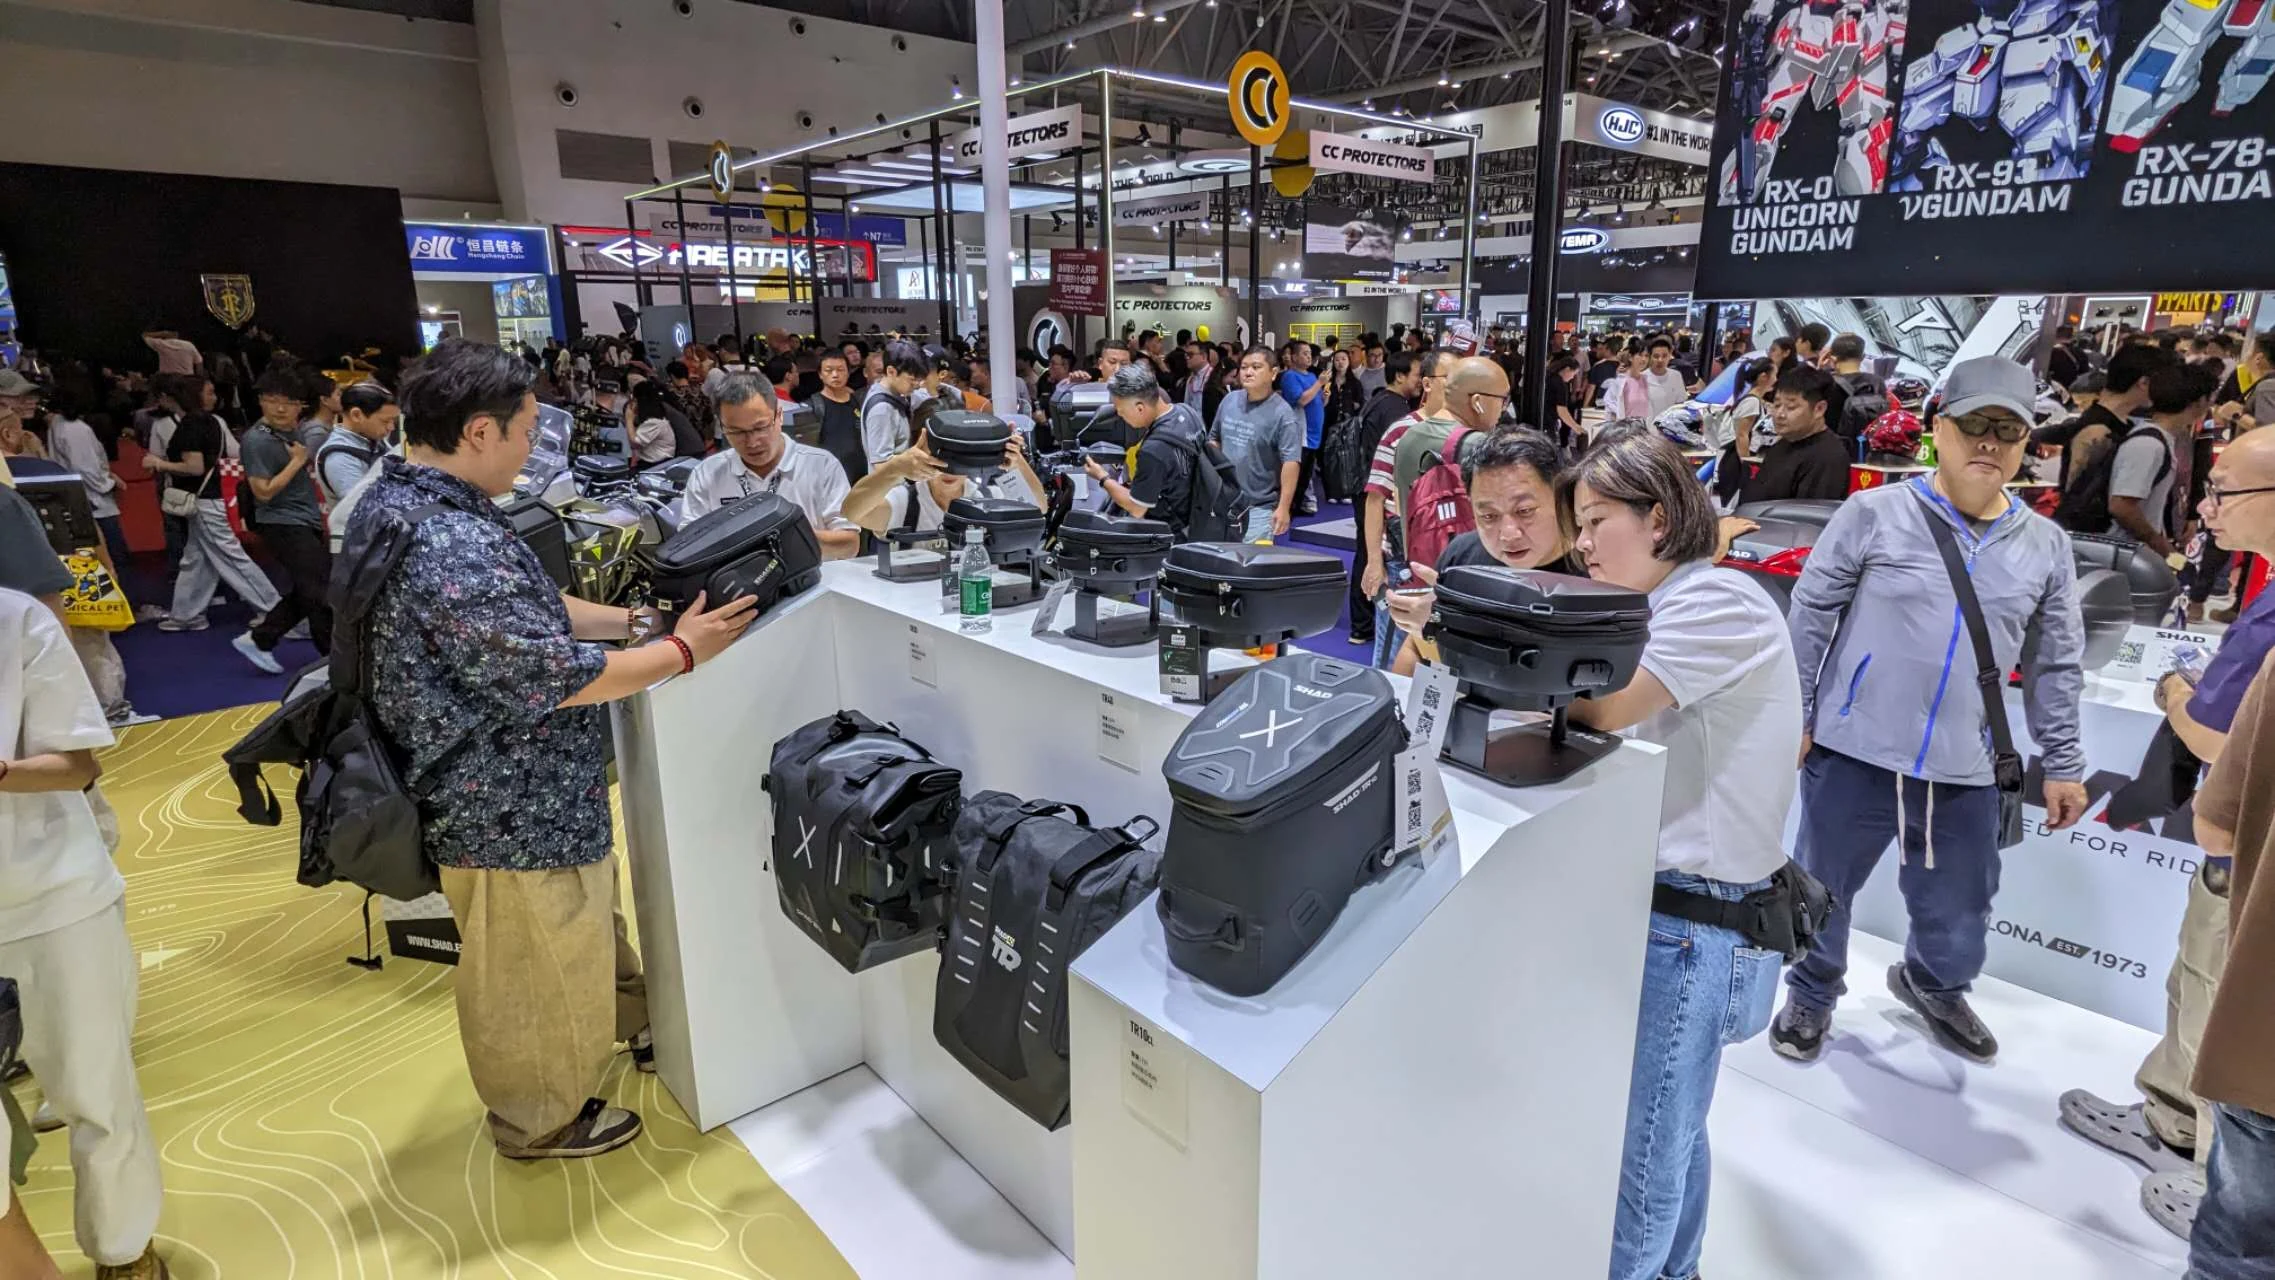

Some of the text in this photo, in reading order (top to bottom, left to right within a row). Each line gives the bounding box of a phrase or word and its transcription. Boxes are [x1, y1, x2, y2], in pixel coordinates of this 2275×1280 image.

[1608, 116, 1640, 136] HJC
[1646, 123, 1659, 142] #1
[1660, 128, 1670, 144] IN
[1670, 130, 1688, 148] THE
[961, 141, 977, 157] CC
[1321, 144, 1427, 172] CC PROTECTORS
[1935, 157, 2038, 191] RX-93
[1764, 176, 1834, 204] RX-0
[1123, 200, 1201, 219] CC PROTECTORS
[1732, 199, 1861, 231] UNICORN
[661, 221, 763, 234] CC PROTETORS
[467, 238, 525, 254] 恒昌链条
[1730, 226, 1855, 255] GUNDAM
[833, 305, 907, 314] CC PROTECTORS
[1114, 300, 1129, 310] CC
[1133, 300, 1212, 312] PROTECTORS
[1290, 303, 1350, 313] CC PROTECTORS
[106, 604, 125, 612] PET
[2155, 631, 2206, 644] SHAD
[1293, 684, 1334, 699] SHAD
[1333, 789, 1360, 814] SHAD
[2070, 831, 2129, 858] FOR
[2145, 850, 2199, 875] RID
[991, 934, 1022, 972] TR
[2055, 941, 2082, 957] EST.
[2091, 950, 2148, 979] 1973
